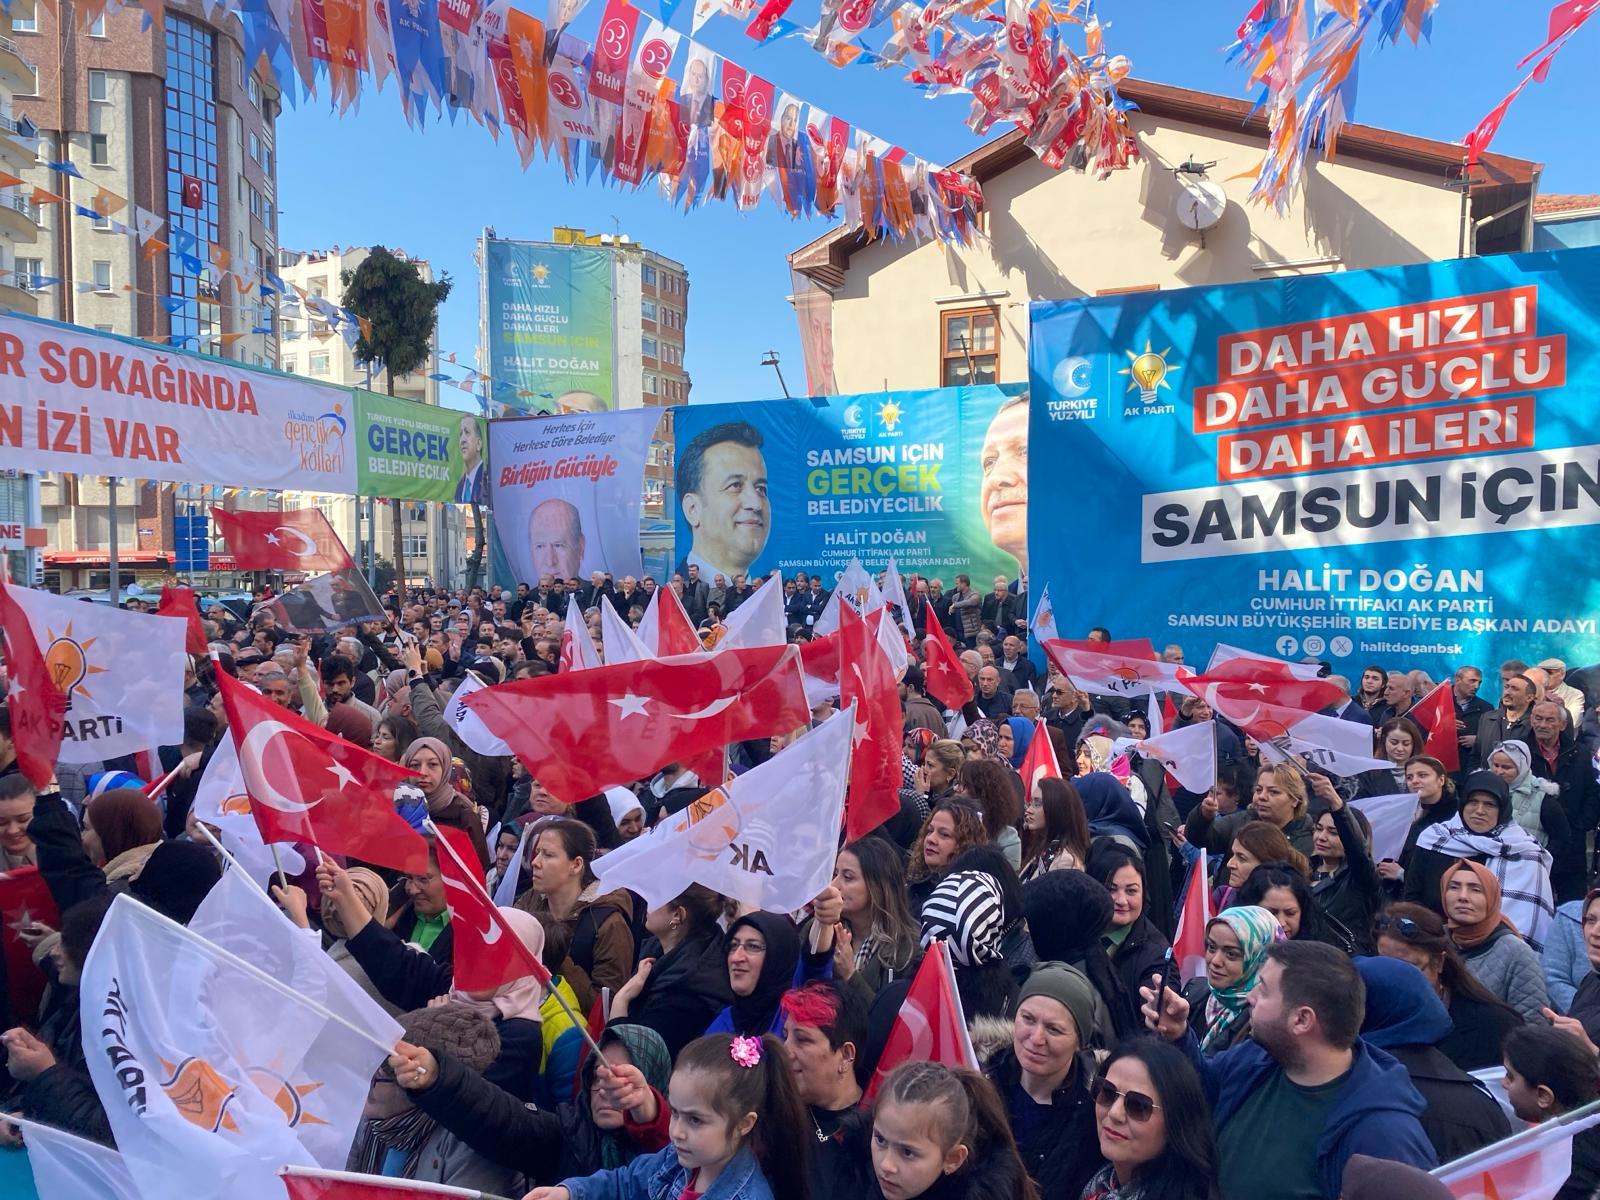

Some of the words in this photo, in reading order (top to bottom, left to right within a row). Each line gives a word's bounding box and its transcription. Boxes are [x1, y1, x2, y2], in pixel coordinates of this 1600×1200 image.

[503, 303, 532, 312] DAHA
[534, 305, 560, 314] HIZLI
[503, 312, 532, 322] DAHA
[503, 322, 533, 332] DAHA
[1231, 322, 1377, 377] DAHA
[1388, 296, 1527, 352] HIZLI
[548, 357, 600, 370] DOĞAN
[39, 341, 259, 416] SOKAĞINDA
[1205, 378, 1348, 427] DAHA
[1361, 345, 1552, 404] GÜÇLÜ
[1124, 407, 1140, 417] AK
[1143, 405, 1175, 415] PARTİ
[37, 400, 92, 455] İZİ
[104, 417, 182, 464] VAR
[543, 424, 577, 436] Herkes
[577, 419, 596, 432] İçin
[368, 423, 450, 462] GERÇEK
[513, 438, 550, 453] Herkese
[551, 436, 574, 449] Göre
[574, 432, 616, 446] Belediye
[1228, 423, 1377, 475] DAHA
[1388, 405, 1519, 456] İLERİ
[807, 445, 896, 467] SAMSUN
[902, 443, 944, 465] İÇİN
[499, 459, 551, 488] Birliğin
[553, 454, 619, 482] Gücüyle
[807, 464, 944, 497] GERÇEK
[807, 496, 944, 516] BELEDİYECİLİK
[1151, 474, 1442, 547] SAMSUN
[1460, 457, 1600, 524] İÇİN
[825, 529, 869, 545] HALİT
[871, 528, 927, 544] DOĞAN
[779, 559, 813, 568] SAMSUN
[906, 558, 940, 568] BAŞKAN
[942, 557, 971, 566] ADAYI
[821, 549, 857, 557] CUMHUR
[906, 547, 931, 556] PARTİ
[1257, 563, 1353, 592] HALİT
[1360, 564, 1484, 593] DOĞAN
[1250, 597, 1326, 611] CUMHUR
[1329, 595, 1403, 612] İTTİFAKI
[1408, 600, 1433, 612] AK
[1438, 596, 1494, 614] PARTİ
[1168, 614, 1239, 628] SAMSUN
[1241, 613, 1352, 632] BÜYÜKŞEHİR
[1355, 614, 1442, 632] BELEDİYE
[1447, 618, 1529, 636] BAŞKAN
[1532, 619, 1597, 634] ADAYI
[1360, 641, 1463, 656] halitdoganbsk
[49, 715, 123, 742] PARTİ
